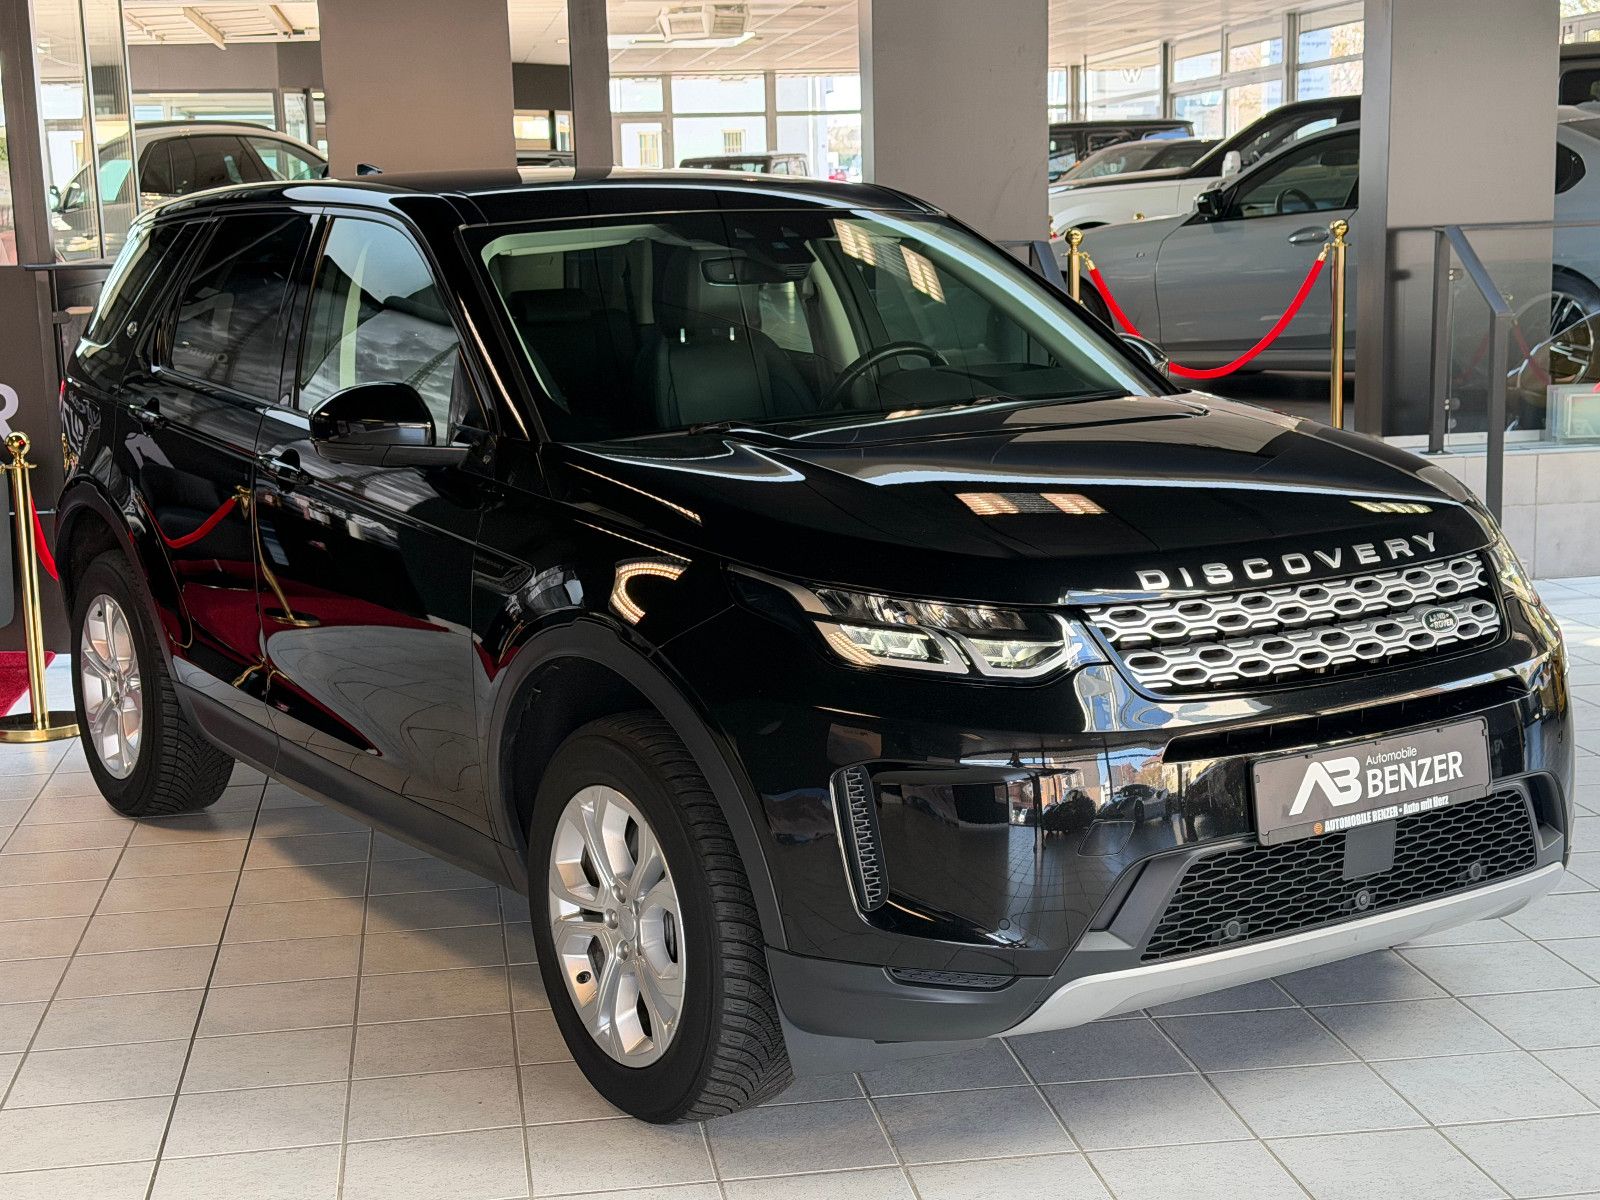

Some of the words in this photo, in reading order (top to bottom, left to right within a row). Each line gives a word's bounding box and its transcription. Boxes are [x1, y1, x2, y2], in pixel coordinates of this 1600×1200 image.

[1135, 531, 1436, 591] DISCOVERY
[1428, 612, 1447, 623] LAND
[1433, 618, 1456, 630] ROVER
[1365, 746, 1418, 766] Automobile
[1366, 751, 1465, 799] BENZER
[1324, 811, 1372, 833] AUTOMOBILE
[1372, 805, 1399, 822] BENZER
[1403, 801, 1420, 815] Auto
